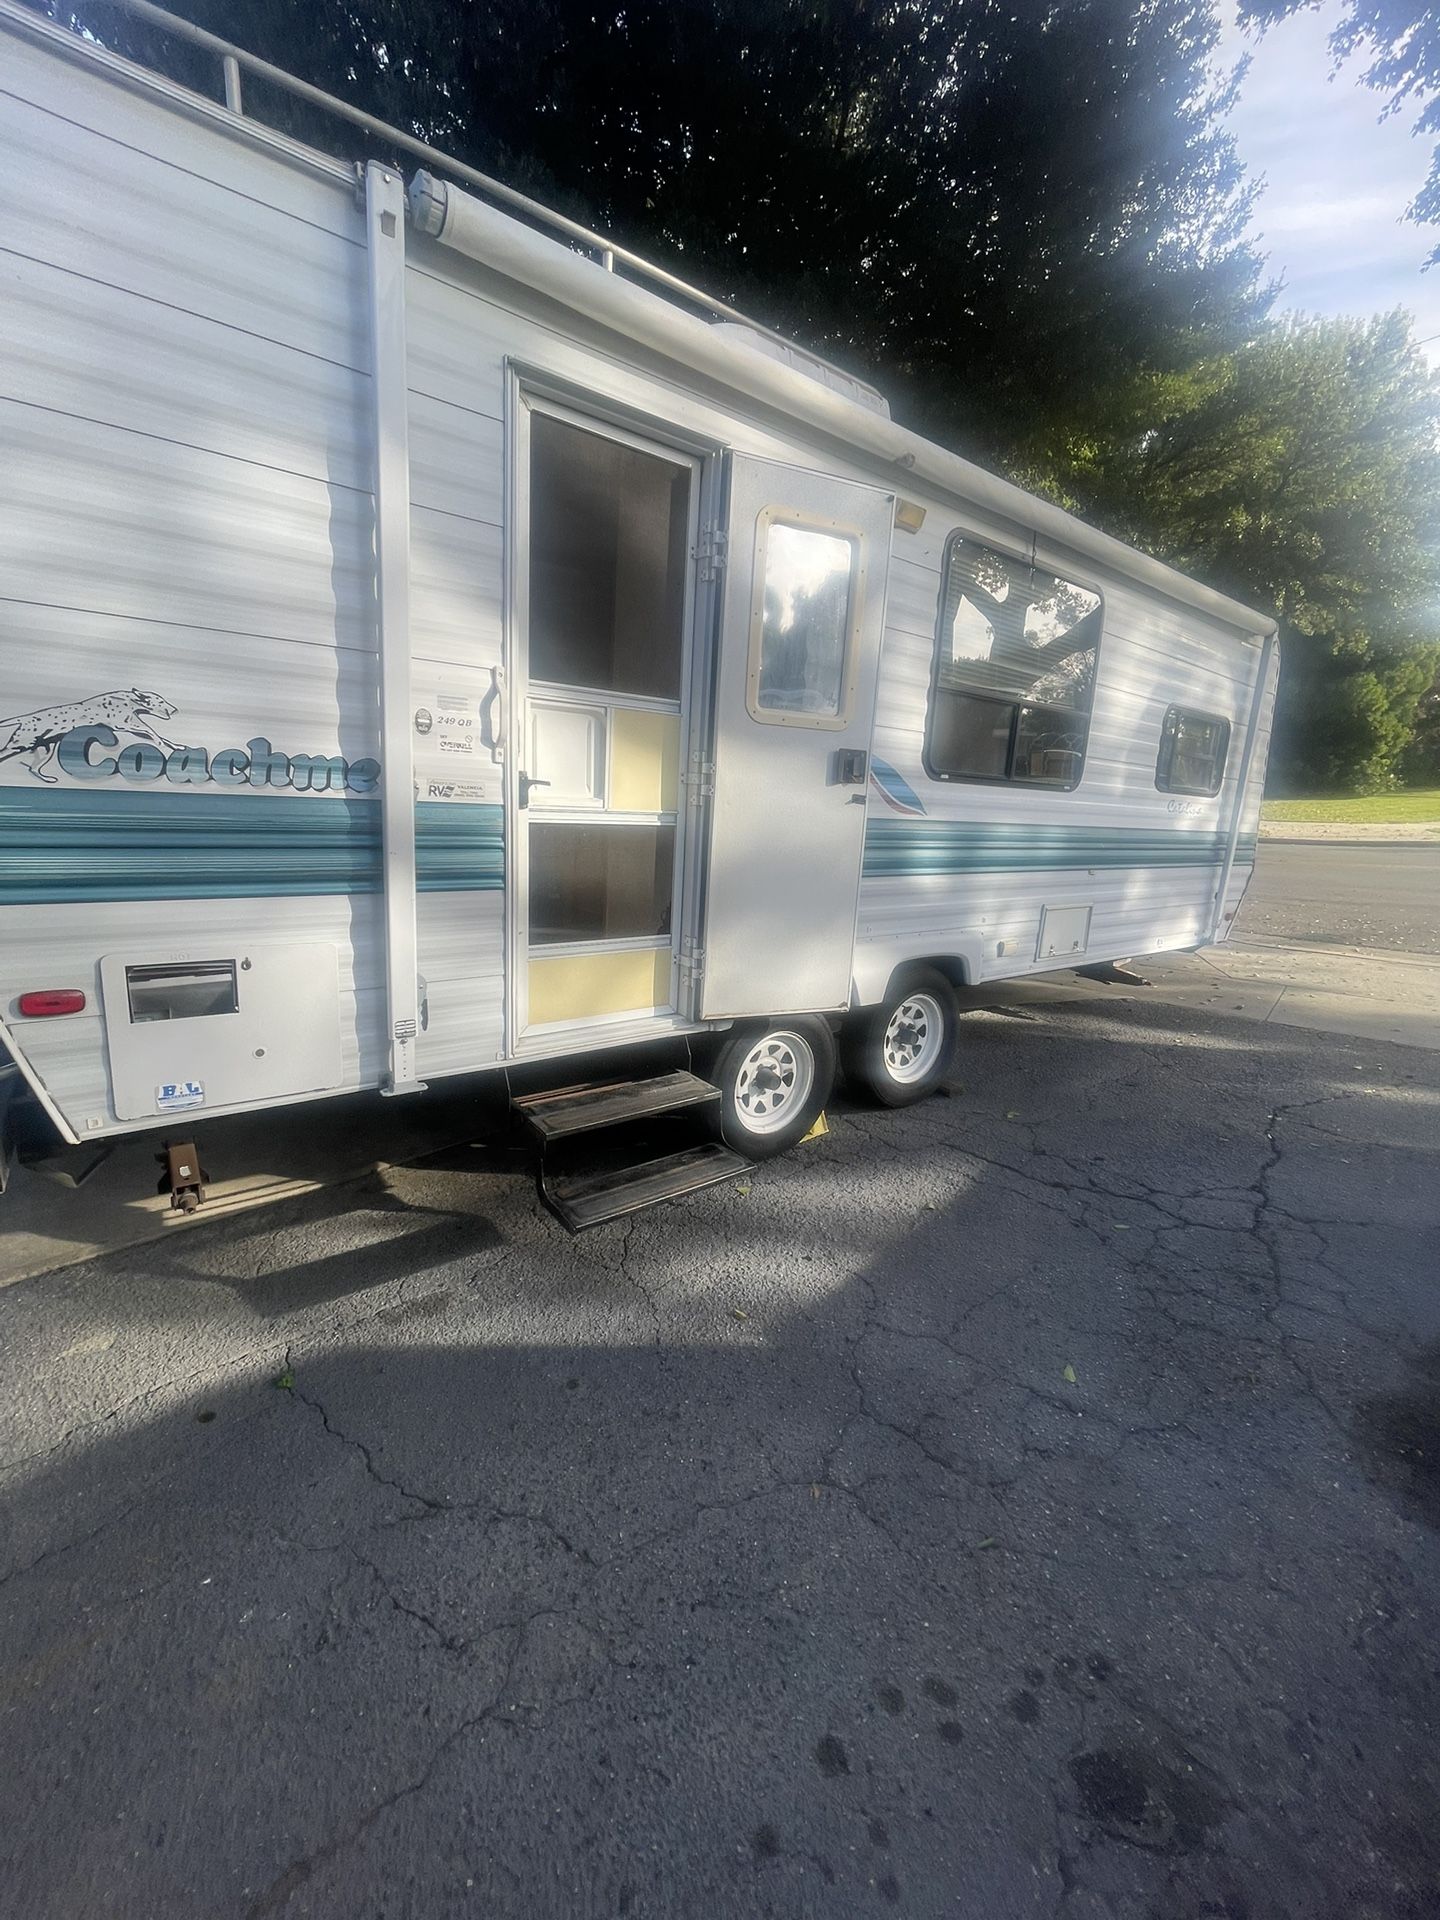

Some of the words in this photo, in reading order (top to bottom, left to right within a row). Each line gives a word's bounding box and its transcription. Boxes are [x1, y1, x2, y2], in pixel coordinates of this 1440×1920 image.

[437, 716, 455, 725] 249
[457, 719, 473, 727] QB
[58, 723, 381, 792] Coachme
